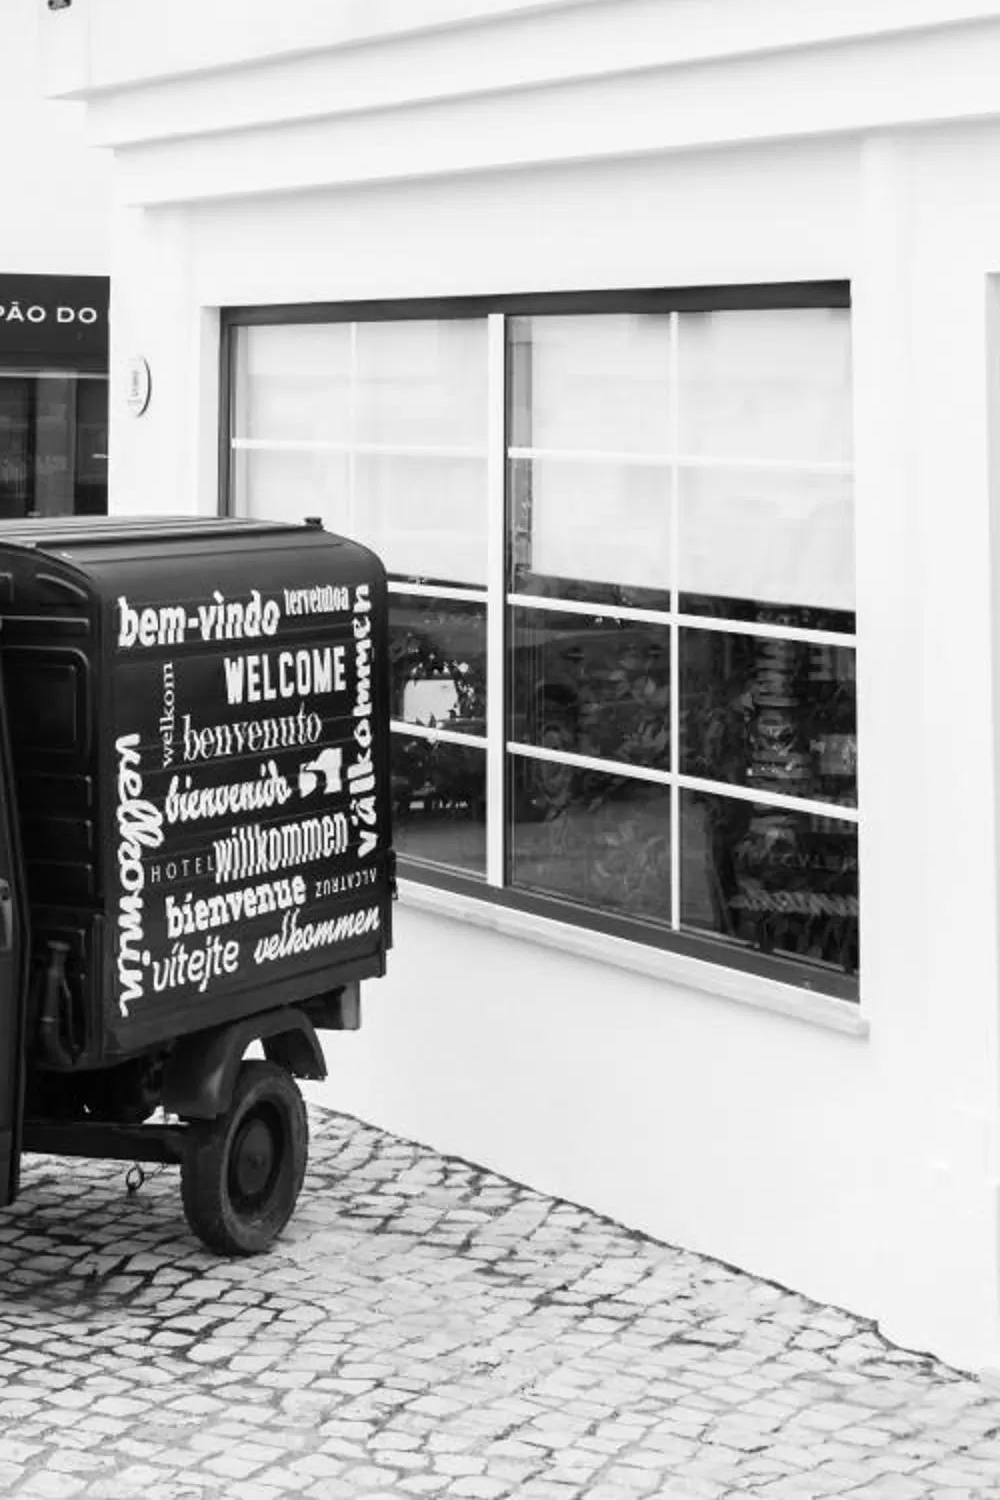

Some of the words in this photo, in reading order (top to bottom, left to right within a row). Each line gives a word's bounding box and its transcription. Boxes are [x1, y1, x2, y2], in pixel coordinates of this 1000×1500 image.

[56, 306, 98, 324] DO
[117, 589, 281, 648] bem-vindo
[223, 645, 347, 704] WELCOME
[159, 661, 176, 768] welkom
[182, 700, 323, 761] benvenuto
[347, 584, 379, 858] välkommen
[164, 759, 293, 824] bienvenido
[150, 854, 215, 883] HOTEL
[212, 811, 349, 884] willkommen
[165, 874, 307, 939] bienvenue
[314, 867, 378, 898] ALCATRUZ
[152, 935, 240, 993] vítejte
[253, 906, 380, 964] velkommen
